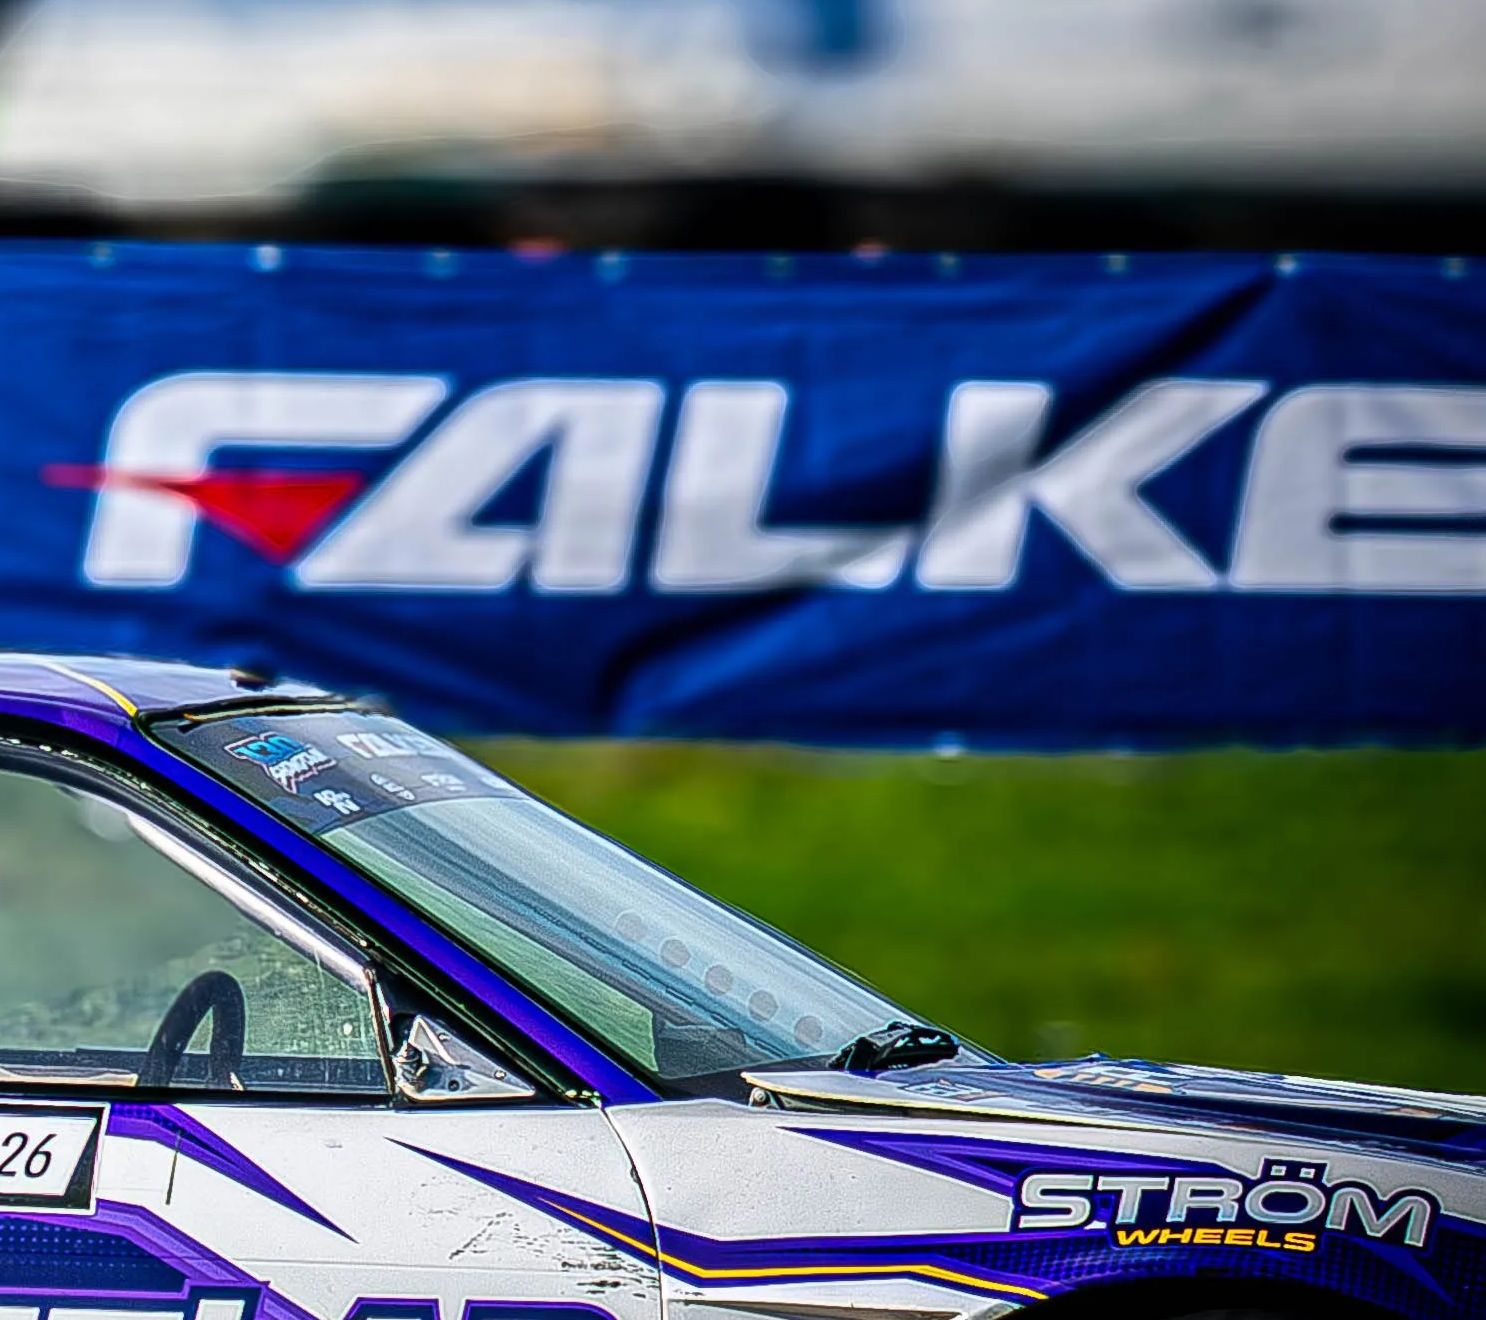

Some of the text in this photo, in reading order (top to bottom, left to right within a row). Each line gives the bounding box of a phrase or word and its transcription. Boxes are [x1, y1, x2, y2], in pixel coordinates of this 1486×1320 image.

[79, 369, 1486, 595] FALKE
[1019, 1164, 1433, 1248] STRÖM
[1115, 1227, 1317, 1253] WHEELS
